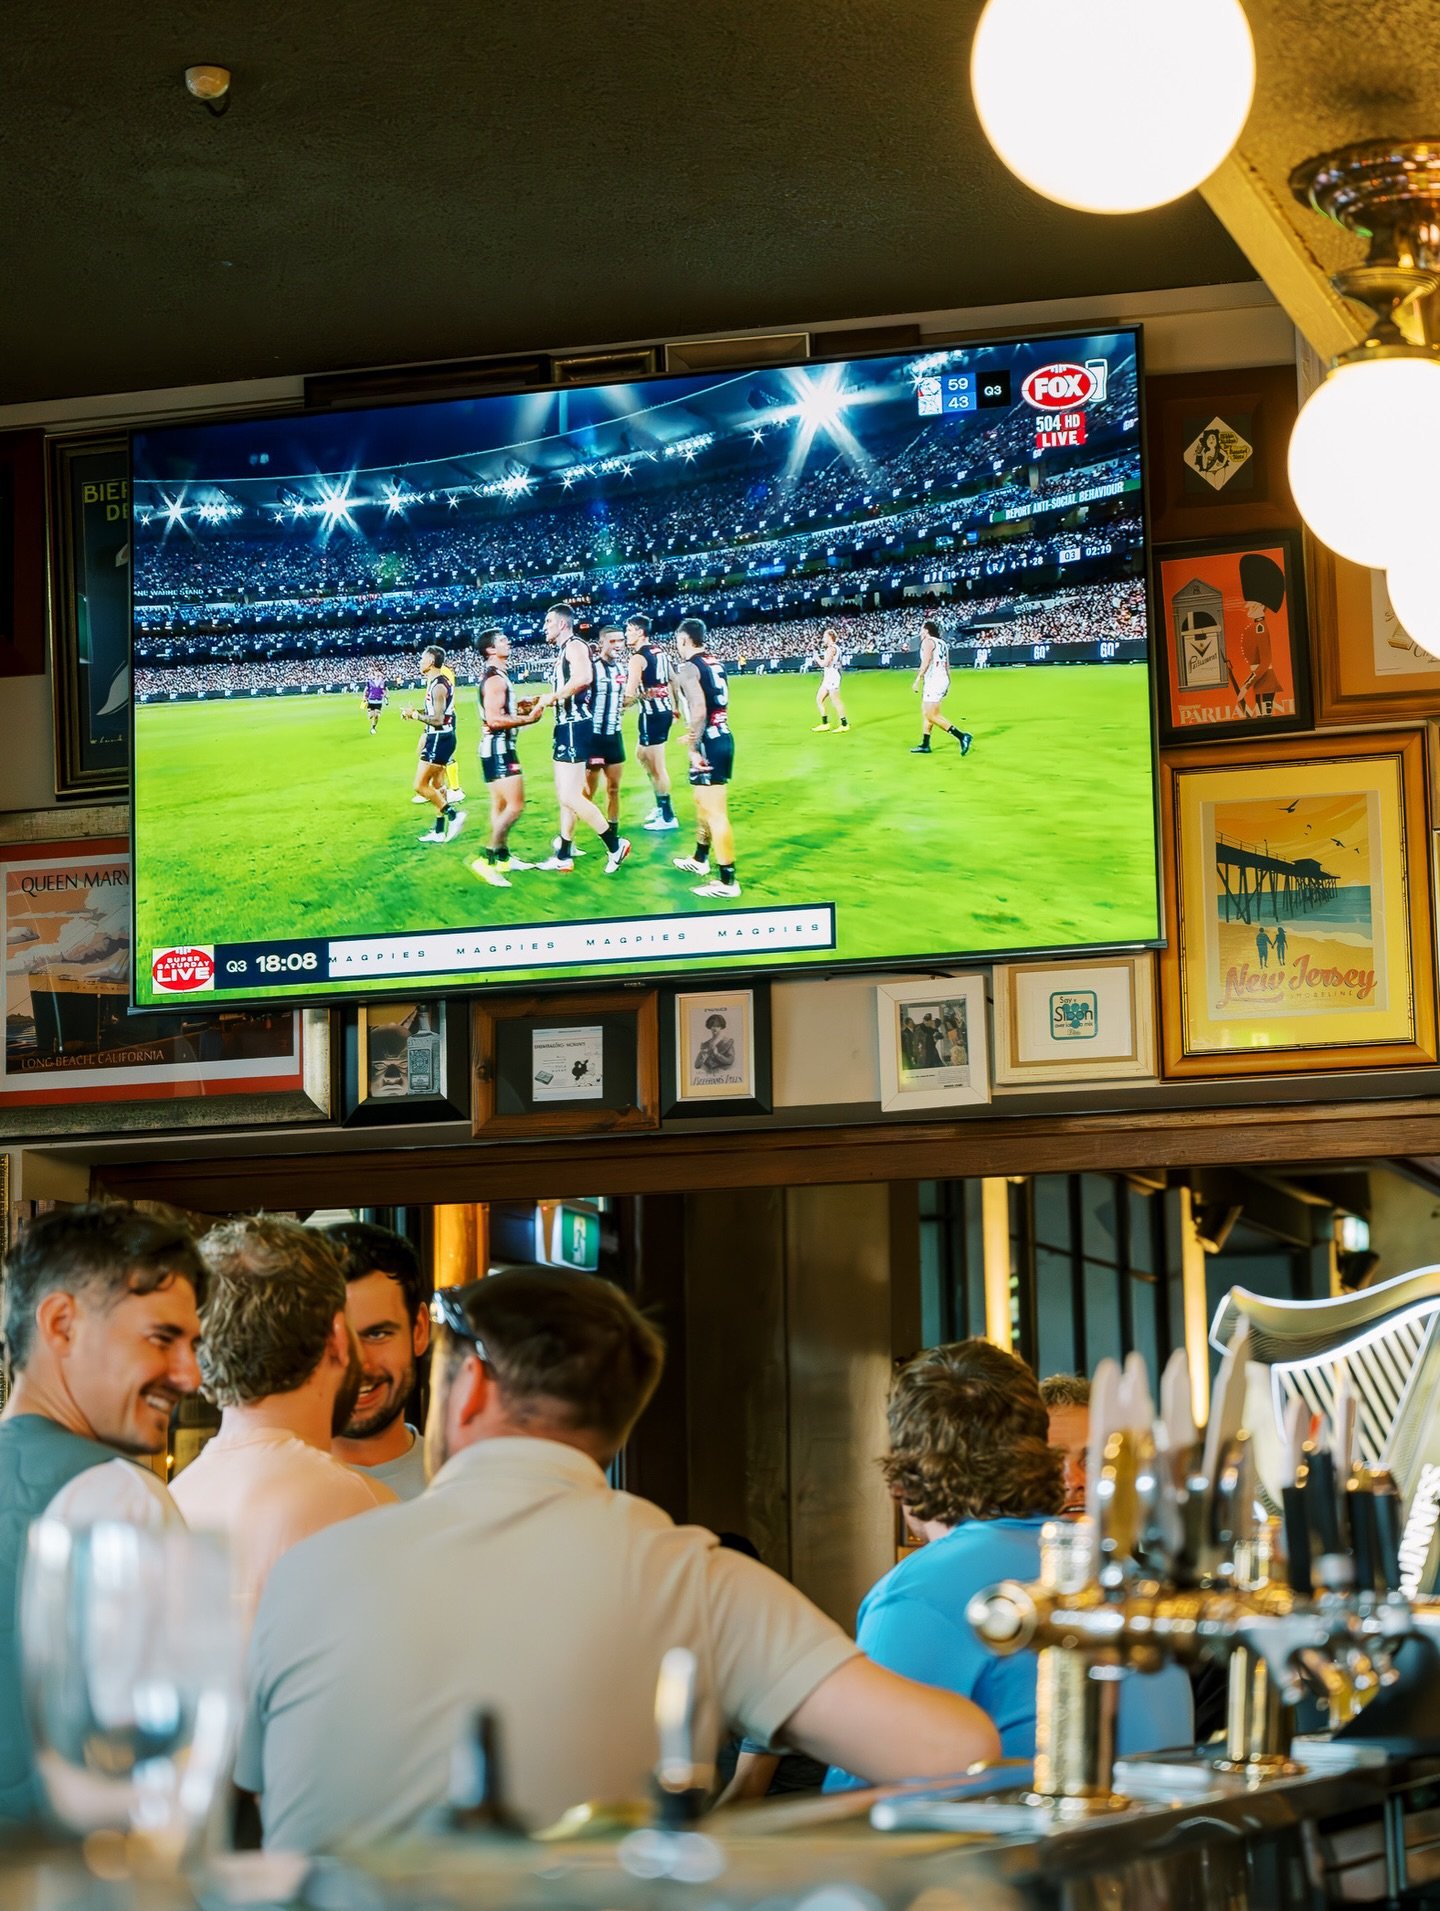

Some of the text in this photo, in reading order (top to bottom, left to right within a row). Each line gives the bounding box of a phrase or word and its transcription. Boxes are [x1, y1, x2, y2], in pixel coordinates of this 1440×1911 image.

[948, 377, 969, 391] 59
[984, 385, 1002, 396] Q3
[1034, 374, 1084, 401] FOX
[948, 395, 969, 409] 43
[1035, 413, 1080, 432] 504 HD
[1041, 430, 1078, 447] LIVE
[1005, 504, 1032, 520] REPORT
[1079, 481, 1125, 502] BEHAVIOUR
[1180, 698, 1296, 725] PARLIAMENT
[21, 874, 77, 897] QUEEN
[718, 923, 819, 938] MAGPIES
[586, 932, 686, 947] MAGPIES
[456, 941, 555, 955] MAGPIES
[166, 955, 200, 964] SUPER
[226, 952, 318, 973] Q3 18:08
[329, 950, 425, 963] MAGPIES
[157, 960, 210, 970] SATURDAY
[156, 967, 210, 983] LIVE
[1217, 954, 1378, 1005] New Jersey
[97, 1049, 165, 1065] CALIFORNIA
